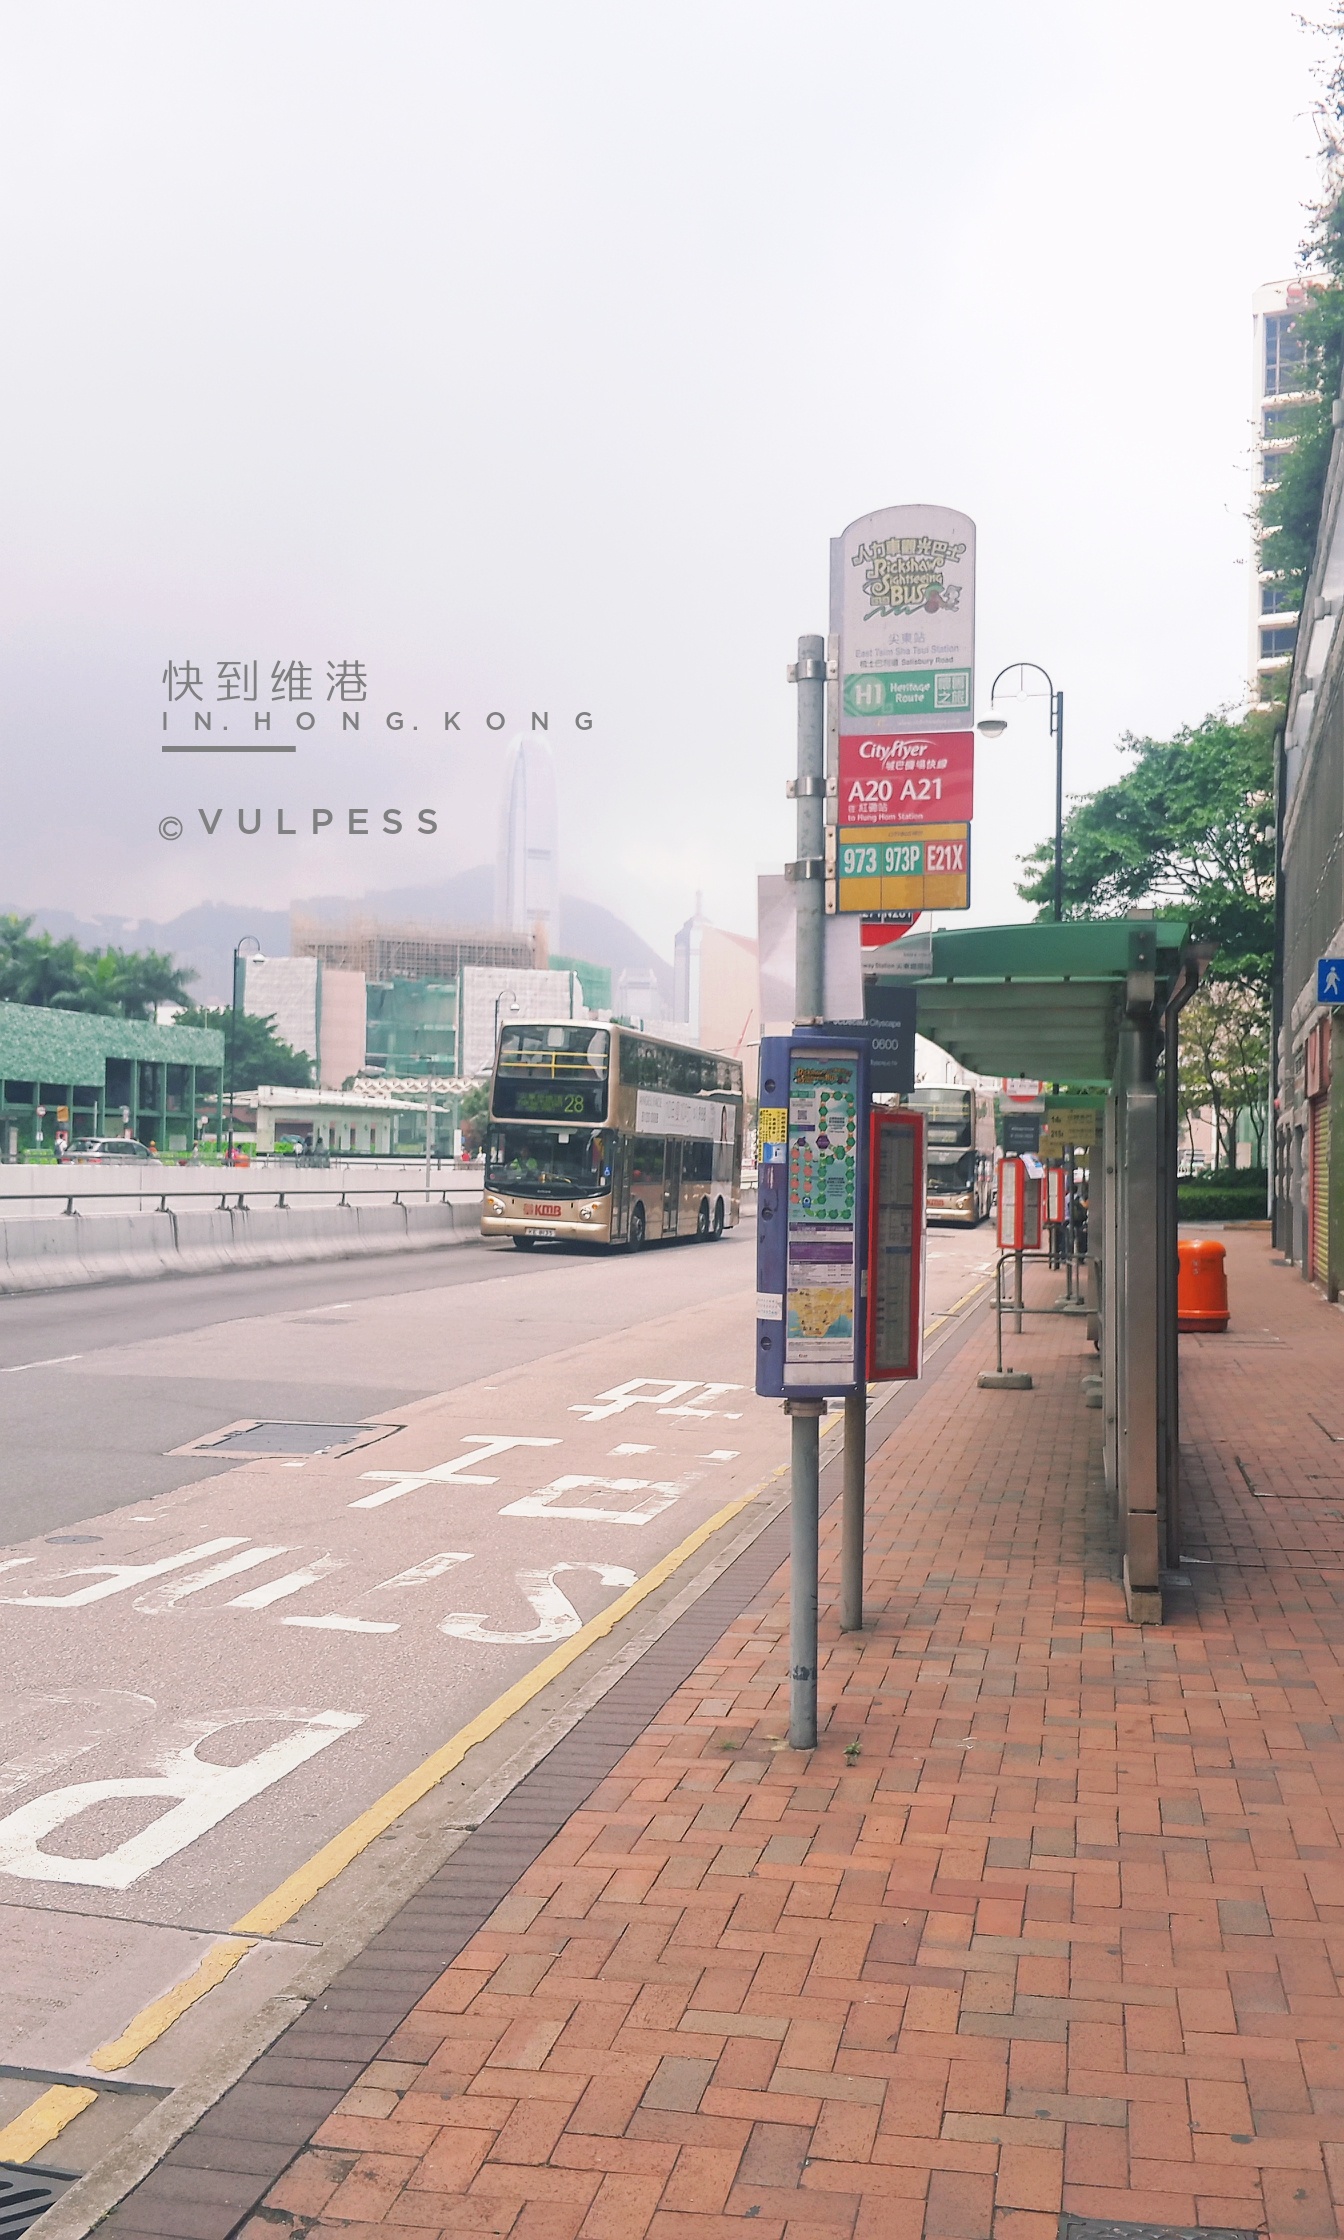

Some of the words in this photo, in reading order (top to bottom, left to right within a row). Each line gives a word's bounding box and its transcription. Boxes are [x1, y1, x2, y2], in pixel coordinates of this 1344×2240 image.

[866, 558, 945, 579] Rickshaw
[931, 644, 960, 654] Station
[935, 656, 954, 664] Road
[855, 683, 882, 706] H1
[890, 682, 931, 694] Heritage
[895, 693, 924, 703] Route
[848, 780, 893, 803] A20
[900, 778, 942, 801] A21
[857, 813, 877, 823] Hung
[879, 813, 896, 821] Hom
[898, 812, 924, 821] Station
[844, 848, 877, 874] 973
[885, 845, 920, 873] 973P
[927, 844, 964, 871] E21X
[564, 1094, 584, 1113] 28
[535, 1204, 562, 1217] KMB
